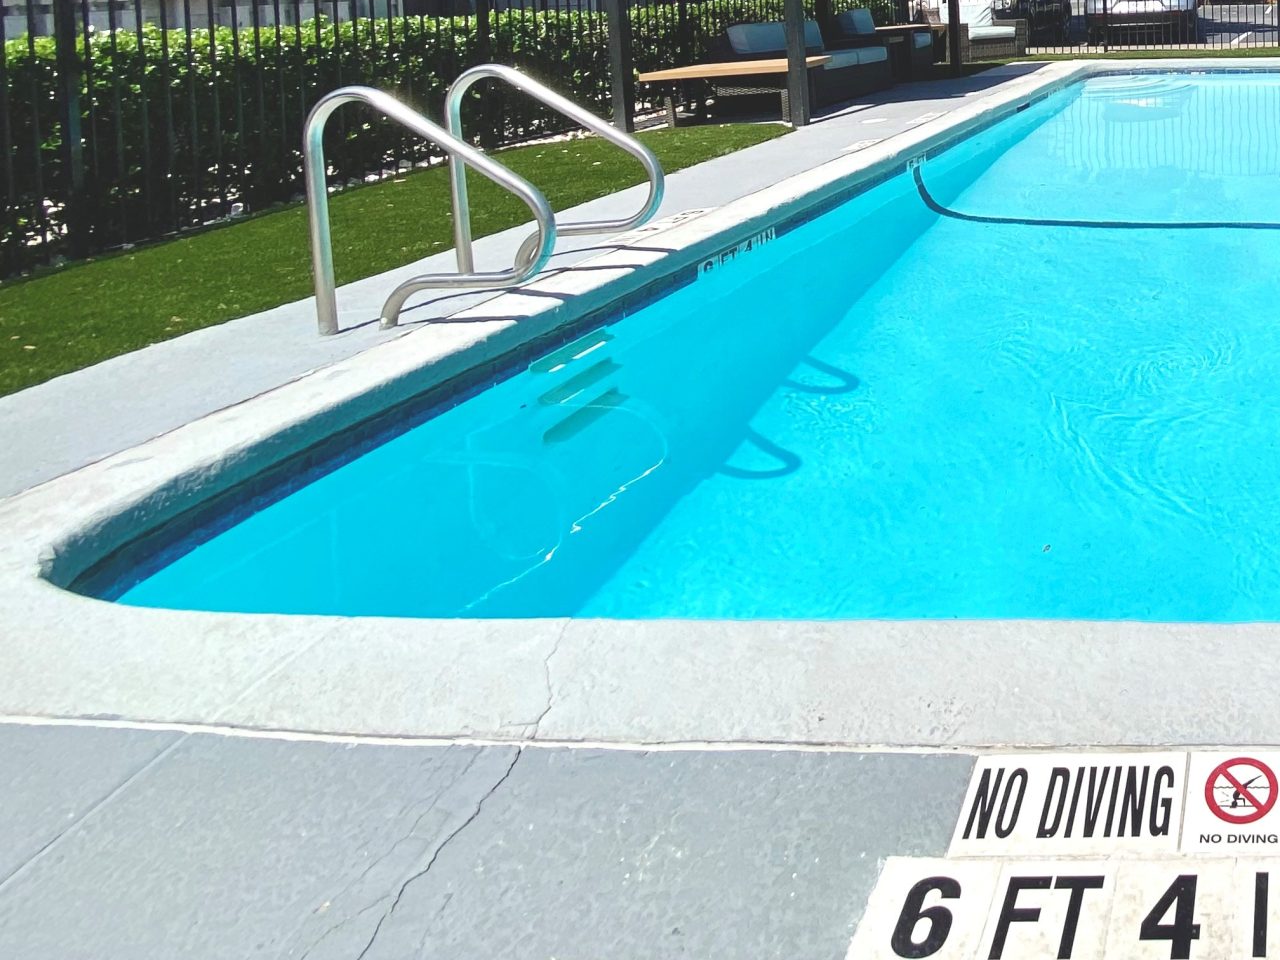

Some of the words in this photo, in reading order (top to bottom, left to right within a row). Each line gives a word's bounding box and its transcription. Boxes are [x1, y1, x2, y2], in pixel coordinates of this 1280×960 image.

[962, 767, 1028, 840] NO
[1036, 764, 1174, 839] DIVING
[1199, 834, 1223, 844] NO
[1226, 834, 1279, 844] DIVING
[891, 875, 962, 960] 6
[988, 874, 1106, 960] FT
[1139, 874, 1200, 960] 4
